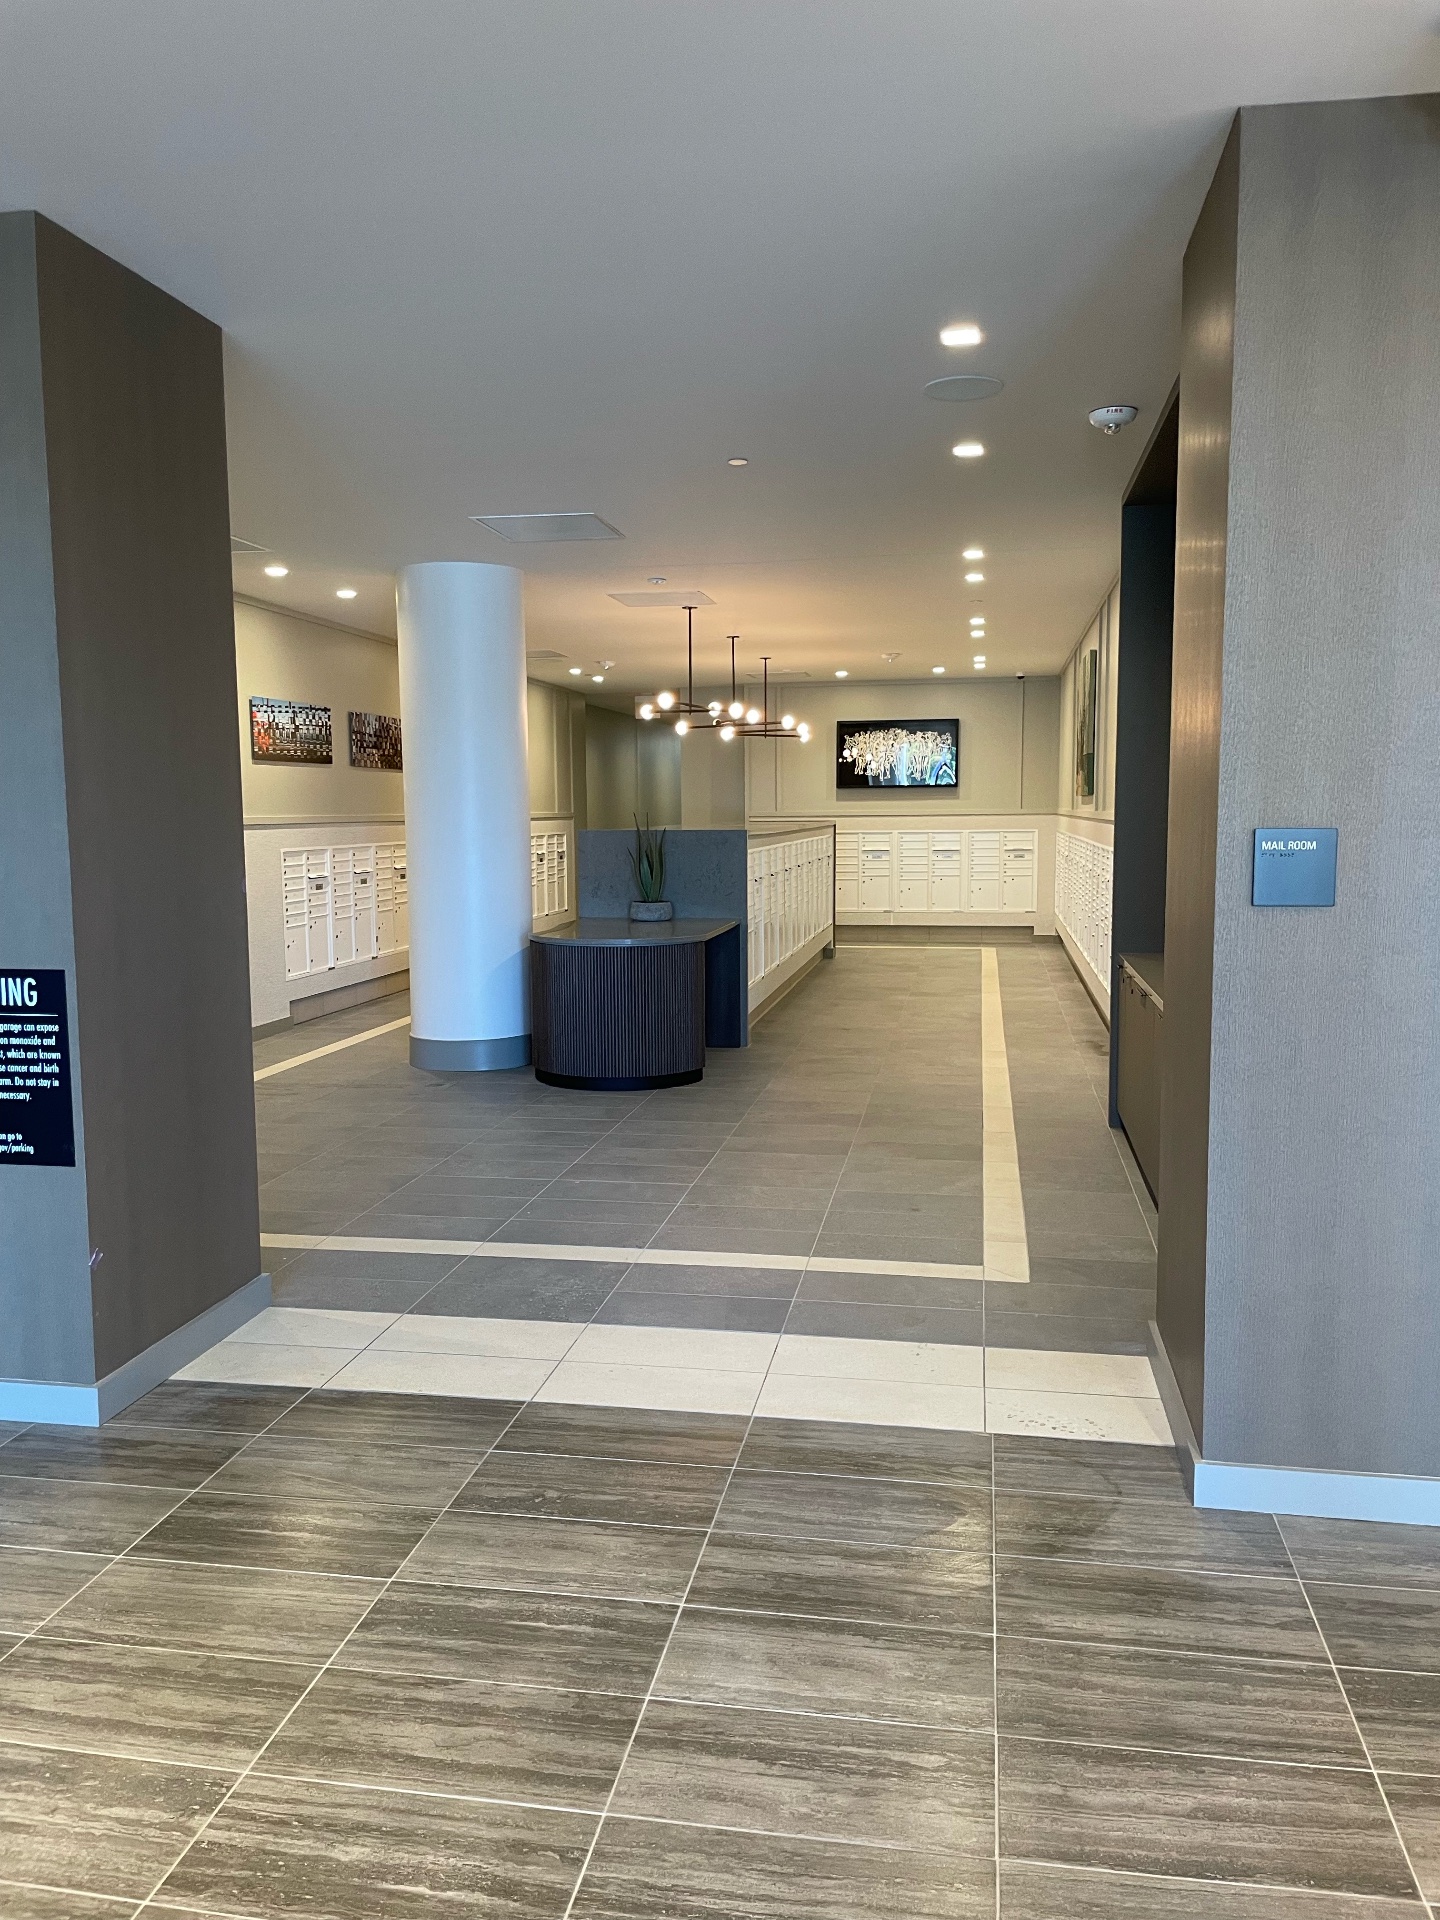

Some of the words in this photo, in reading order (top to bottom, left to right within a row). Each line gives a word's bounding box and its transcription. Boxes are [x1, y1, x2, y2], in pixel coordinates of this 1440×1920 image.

[1262, 840, 1286, 850] MAIL
[1288, 840, 1316, 850] ROOM
[0, 978, 38, 1006] ING
[0, 1024, 22, 1034] garage
[36, 1024, 60, 1034] expose
[10, 1034, 42, 1046] monoxide
[42, 1035, 56, 1046] and
[6, 1048, 26, 1058] which
[38, 1048, 62, 1060] known
[29, 1062, 42, 1072] and
[44, 1062, 60, 1073] birth
[14, 1076, 24, 1086] Do
[26, 1078, 36, 1086] not
[38, 1078, 51, 1088] stay
[52, 1078, 60, 1086] in
[8, 1134, 16, 1142] go
[16, 1132, 22, 1140] to
